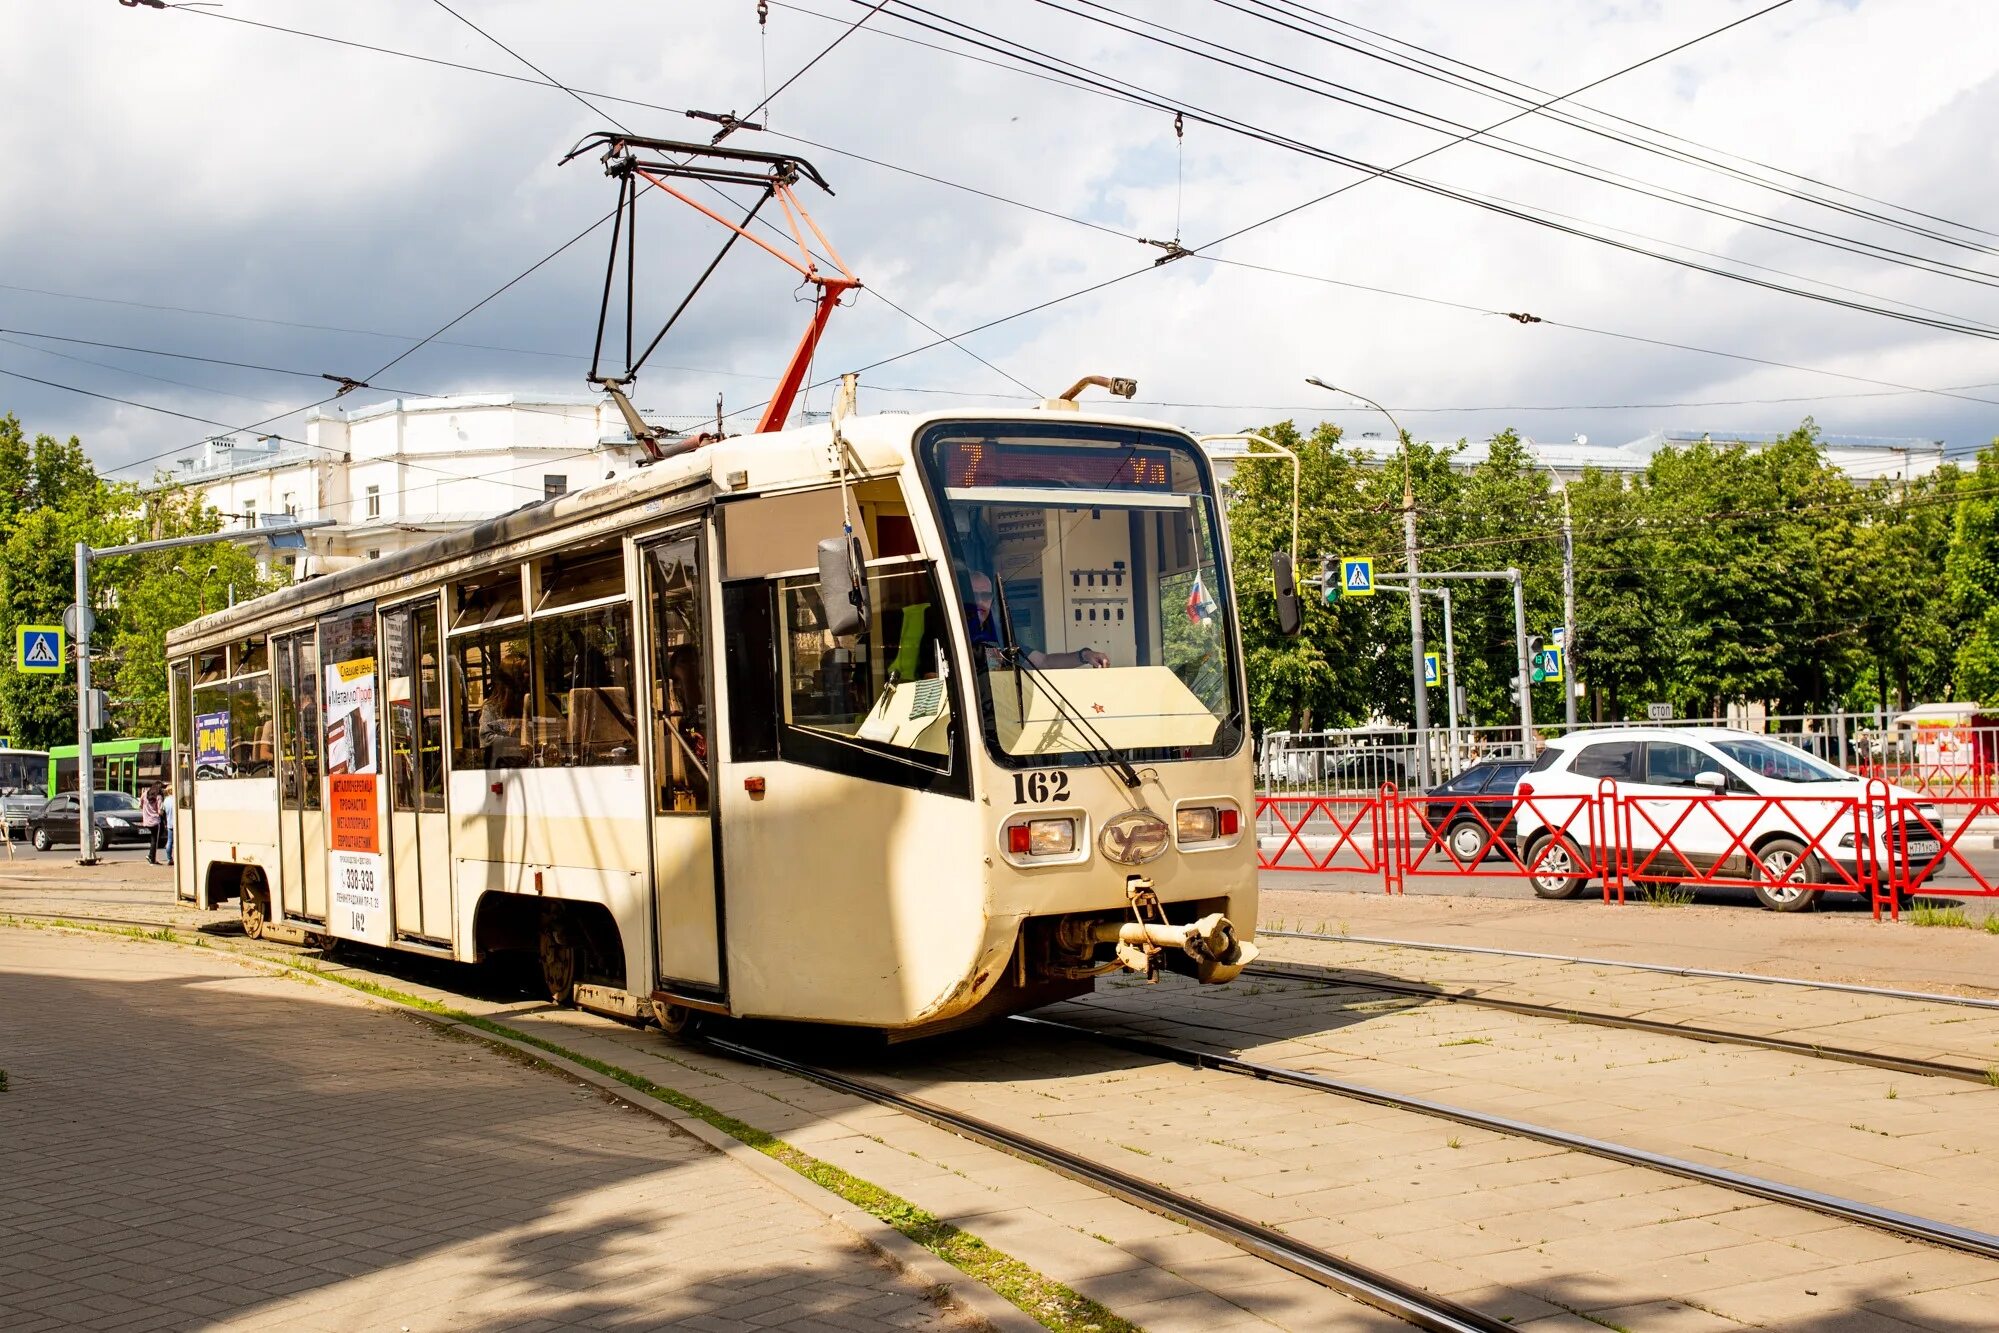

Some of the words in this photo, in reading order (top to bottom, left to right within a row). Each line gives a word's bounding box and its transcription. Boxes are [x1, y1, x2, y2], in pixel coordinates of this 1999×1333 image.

[961, 444, 982, 486] 7
[331, 684, 373, 704] МеталлоПроф
[1651, 705, 1671, 717] СТОП
[333, 779, 373, 795] МЕТАЛЛОЧЕРЕПИЦА
[1012, 770, 1071, 805] 162
[339, 798, 367, 812] ПРОФНАСТИЛ
[336, 816, 371, 830] МЕТАЛЛОПРОКАТ
[346, 868, 374, 891] 338-339
[351, 911, 365, 932] 162
